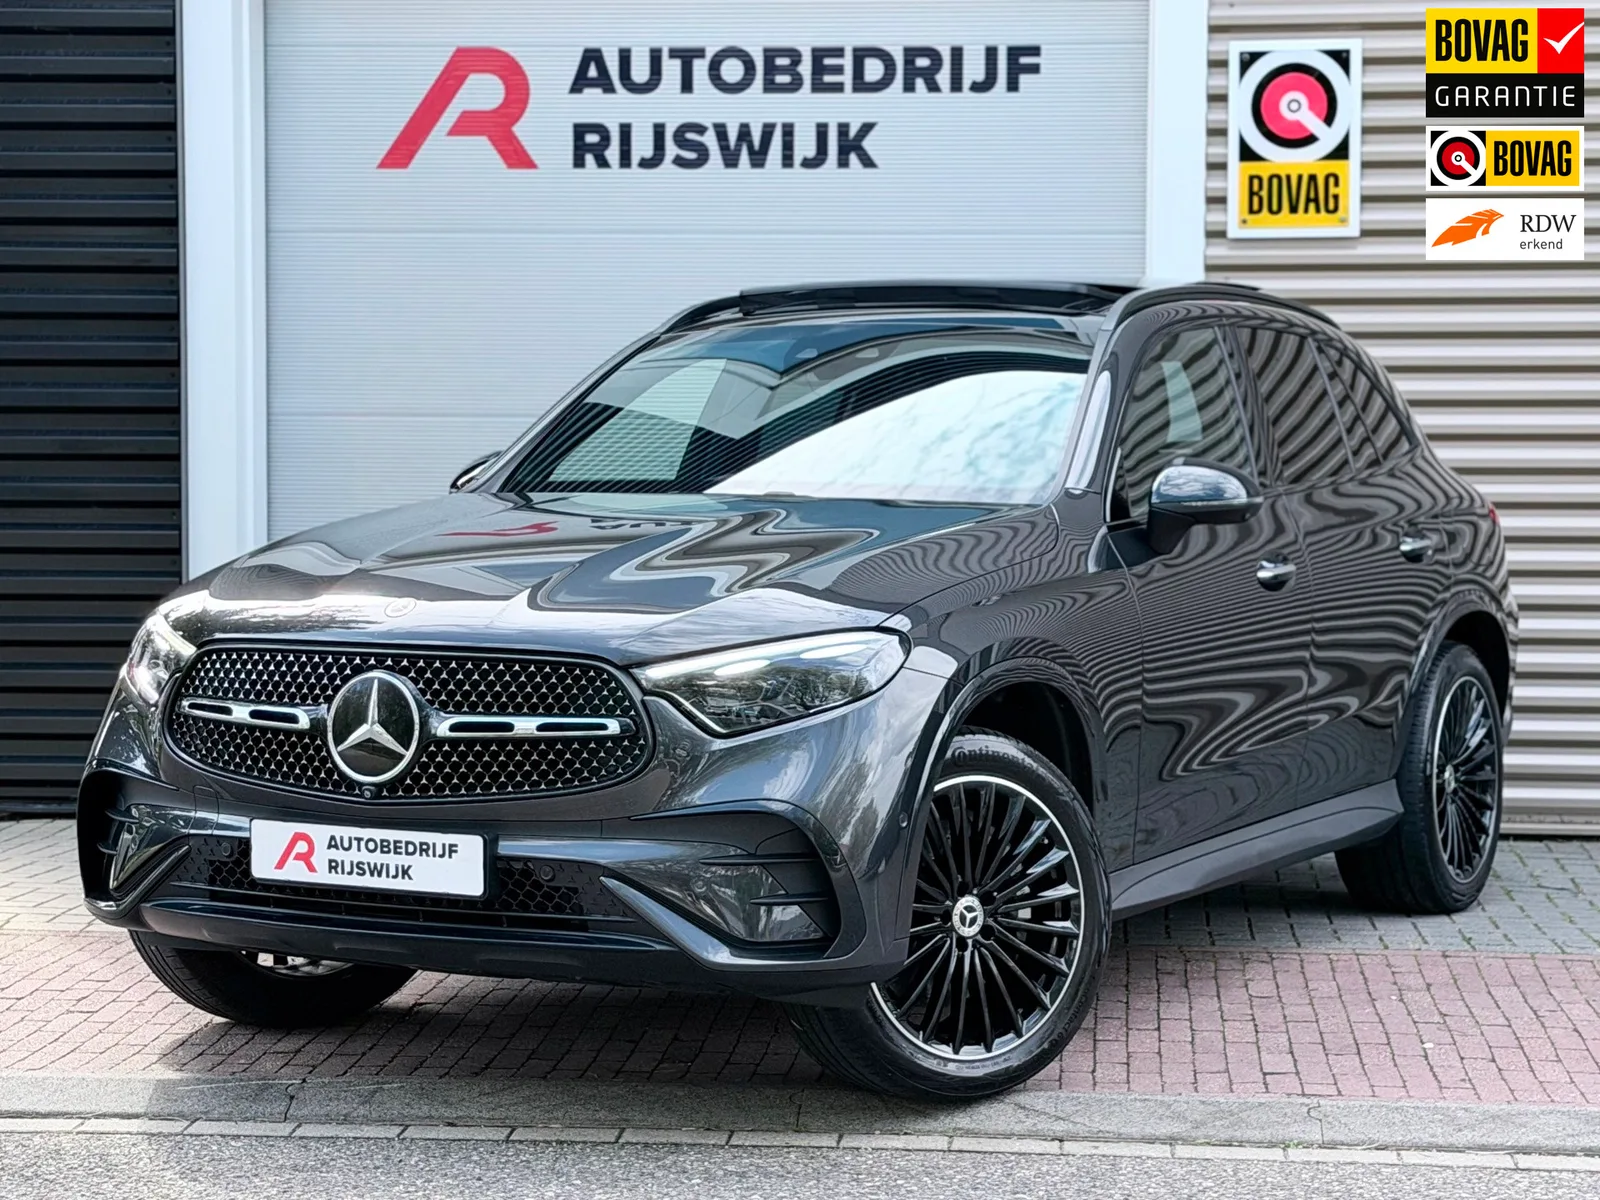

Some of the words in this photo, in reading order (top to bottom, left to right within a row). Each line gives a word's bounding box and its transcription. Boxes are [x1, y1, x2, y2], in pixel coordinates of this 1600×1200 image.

[568, 45, 1042, 95] AUTOBEDRIJF
[571, 122, 880, 170] RIJSWIJK
[1247, 173, 1340, 216] BOVAG
[326, 834, 459, 859] AUTOBEDRIJF
[328, 859, 414, 881] RIJSWIJK
